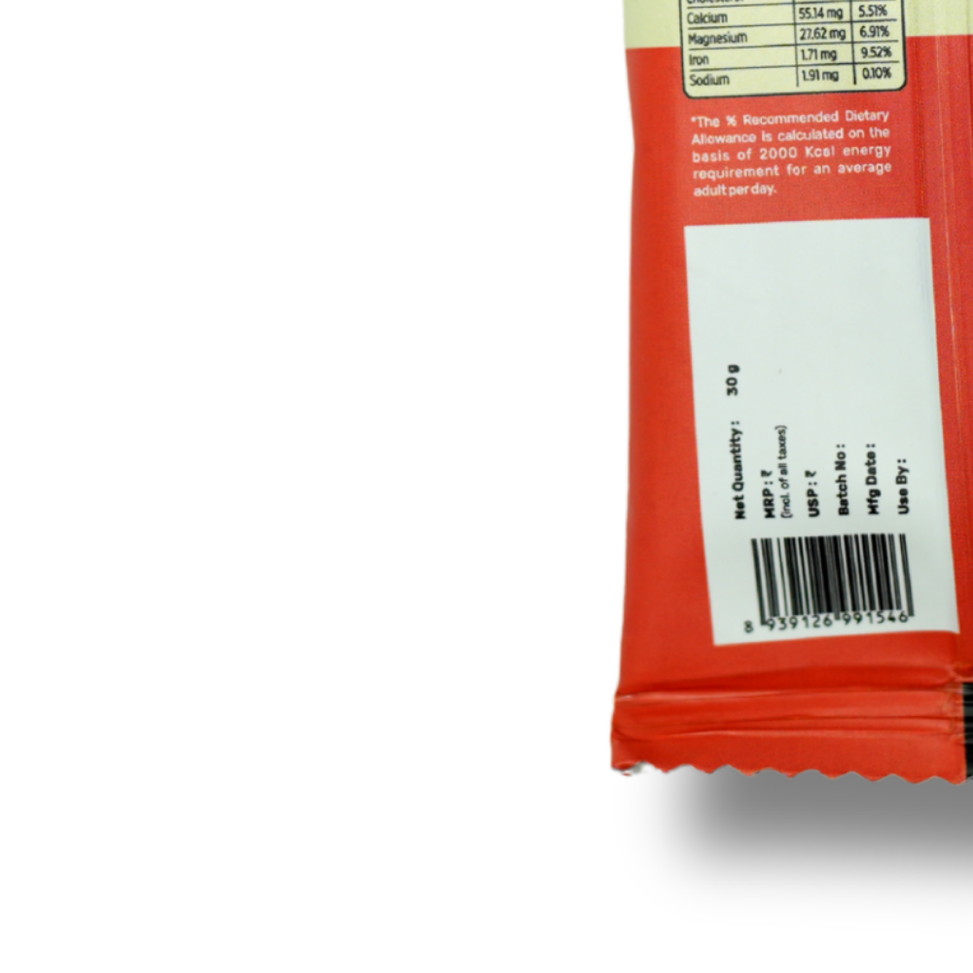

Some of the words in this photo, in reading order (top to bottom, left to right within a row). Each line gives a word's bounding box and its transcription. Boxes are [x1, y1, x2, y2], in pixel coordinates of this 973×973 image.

[688, 11, 728, 24] Calcium
[799, 8, 824, 19] 55.14
[827, 8, 843, 20] mg
[858, 4, 888, 17] 5.51%
[688, 32, 748, 46] Magnesium
[799, 28, 827, 40] 27.62
[830, 29, 846, 41] mg
[859, 26, 890, 37] 6.91%
[689, 55, 709, 66] Iron
[801, 49, 818, 60] 1.71
[821, 50, 837, 61] mg
[861, 47, 892, 58] 9.52%
[690, 74, 730, 86] Sodium
[802, 70, 820, 81] 1.91
[822, 71, 839, 82] mg
[862, 68, 892, 80] 0.10%
[726, 115, 737, 126] %
[743, 111, 839, 126] Recommended
[845, 110, 890, 123] Dietary
[692, 134, 756, 145] Allowance
[762, 130, 773, 142] is
[777, 128, 844, 141] calculated
[848, 129, 864, 138] on
[869, 127, 890, 137] the
[692, 150, 730, 163] basis
[737, 149, 752, 160] of
[759, 147, 798, 160] 2000
[843, 145, 892, 158] energy
[693, 166, 779, 180] requirement
[786, 164, 807, 175] for
[813, 164, 831, 174] an
[838, 162, 892, 175] average
[693, 185, 727, 197] adult
[729, 185, 749, 196] per
[728, 364, 741, 374] g
[726, 377, 738, 396] 30
[774, 425, 788, 460] taxes)
[778, 463, 788, 475] all
[780, 476, 790, 490] of
[836, 474, 850, 516] Batch
[867, 489, 881, 515] Mfg
[898, 489, 910, 515] Use
[733, 494, 746, 519] Net
[744, 620, 754, 634] 8
[767, 613, 833, 631] 939126
[841, 610, 908, 625] 991546
